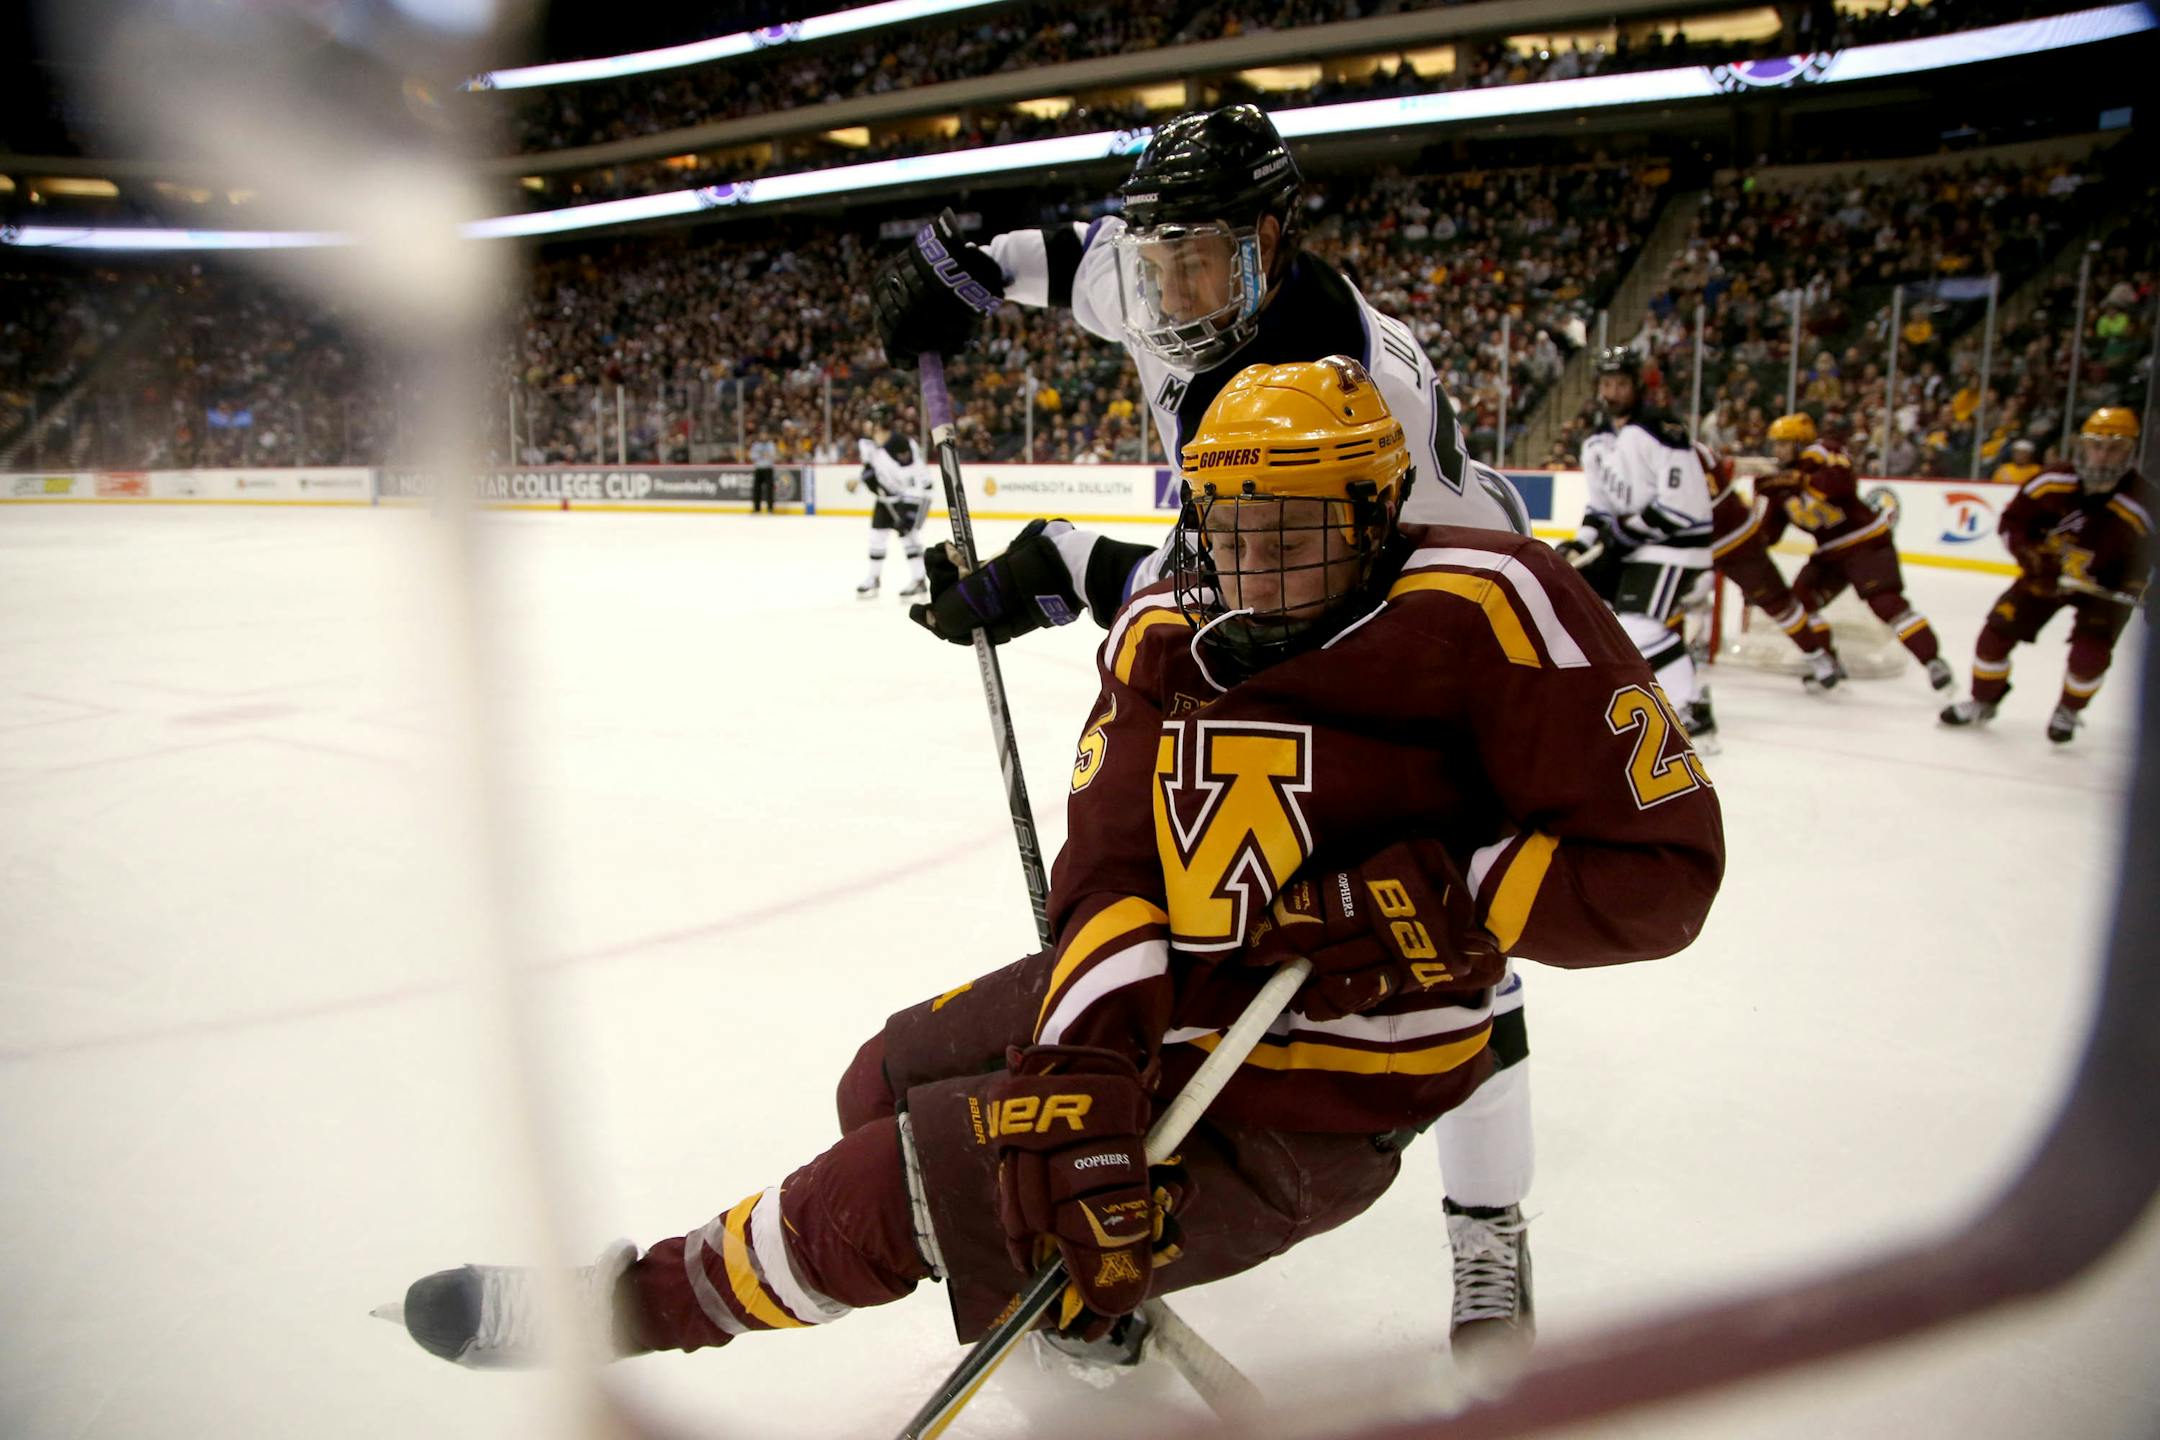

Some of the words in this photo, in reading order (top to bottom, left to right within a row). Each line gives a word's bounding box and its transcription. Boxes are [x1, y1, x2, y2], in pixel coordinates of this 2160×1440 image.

[1200, 448, 1261, 469] GOPHERS
[512, 473, 602, 498] COLLEGE
[605, 474, 651, 497] CUP
[1001, 480, 1074, 492] MINNESOTA
[1079, 482, 1133, 495] DULUTH
[1669, 467, 1682, 489] 6
[1071, 692, 1116, 794] 5
[1338, 872, 1354, 918] GOPHERS
[968, 1097, 986, 1145] BAUER
[1074, 1153, 1130, 1170] GOPHERS
